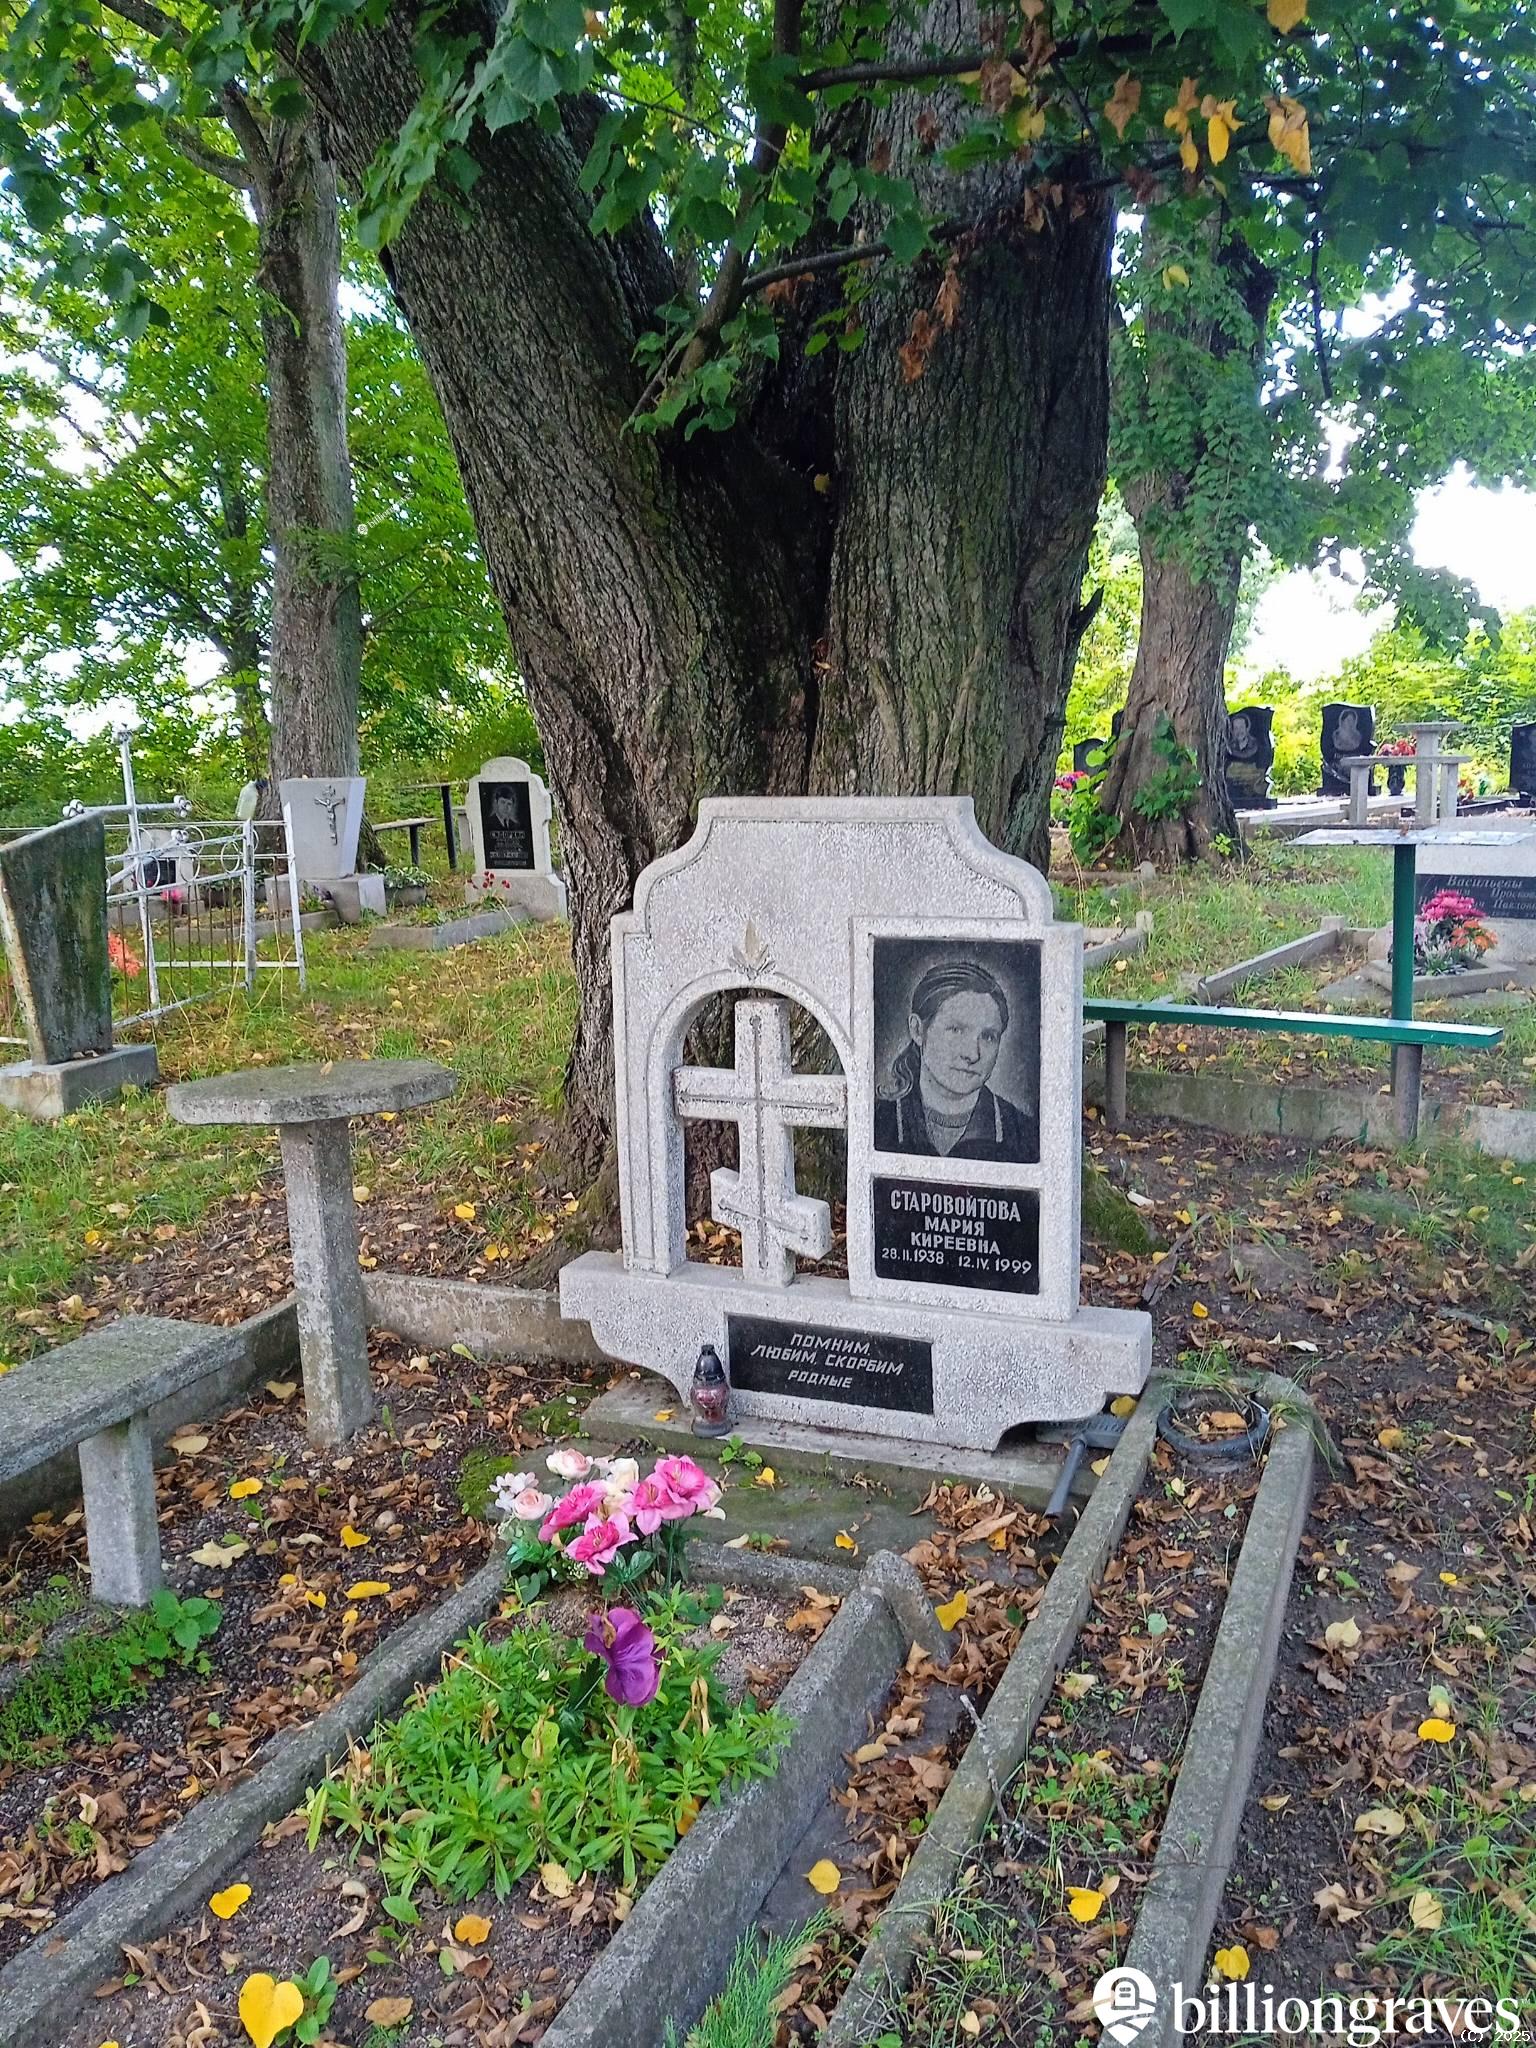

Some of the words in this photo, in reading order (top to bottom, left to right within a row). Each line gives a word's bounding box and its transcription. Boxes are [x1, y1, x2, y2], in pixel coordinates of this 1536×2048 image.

[890, 1189, 1021, 1222] СТАРОВОЙТОВА
[924, 1216, 985, 1236] МАРИЯ
[911, 1232, 1000, 1255] КИРЕЕВНА
[825, 1354, 904, 1376] СКОРБИМ
[788, 1369, 853, 1388] РОДНЫЕ
